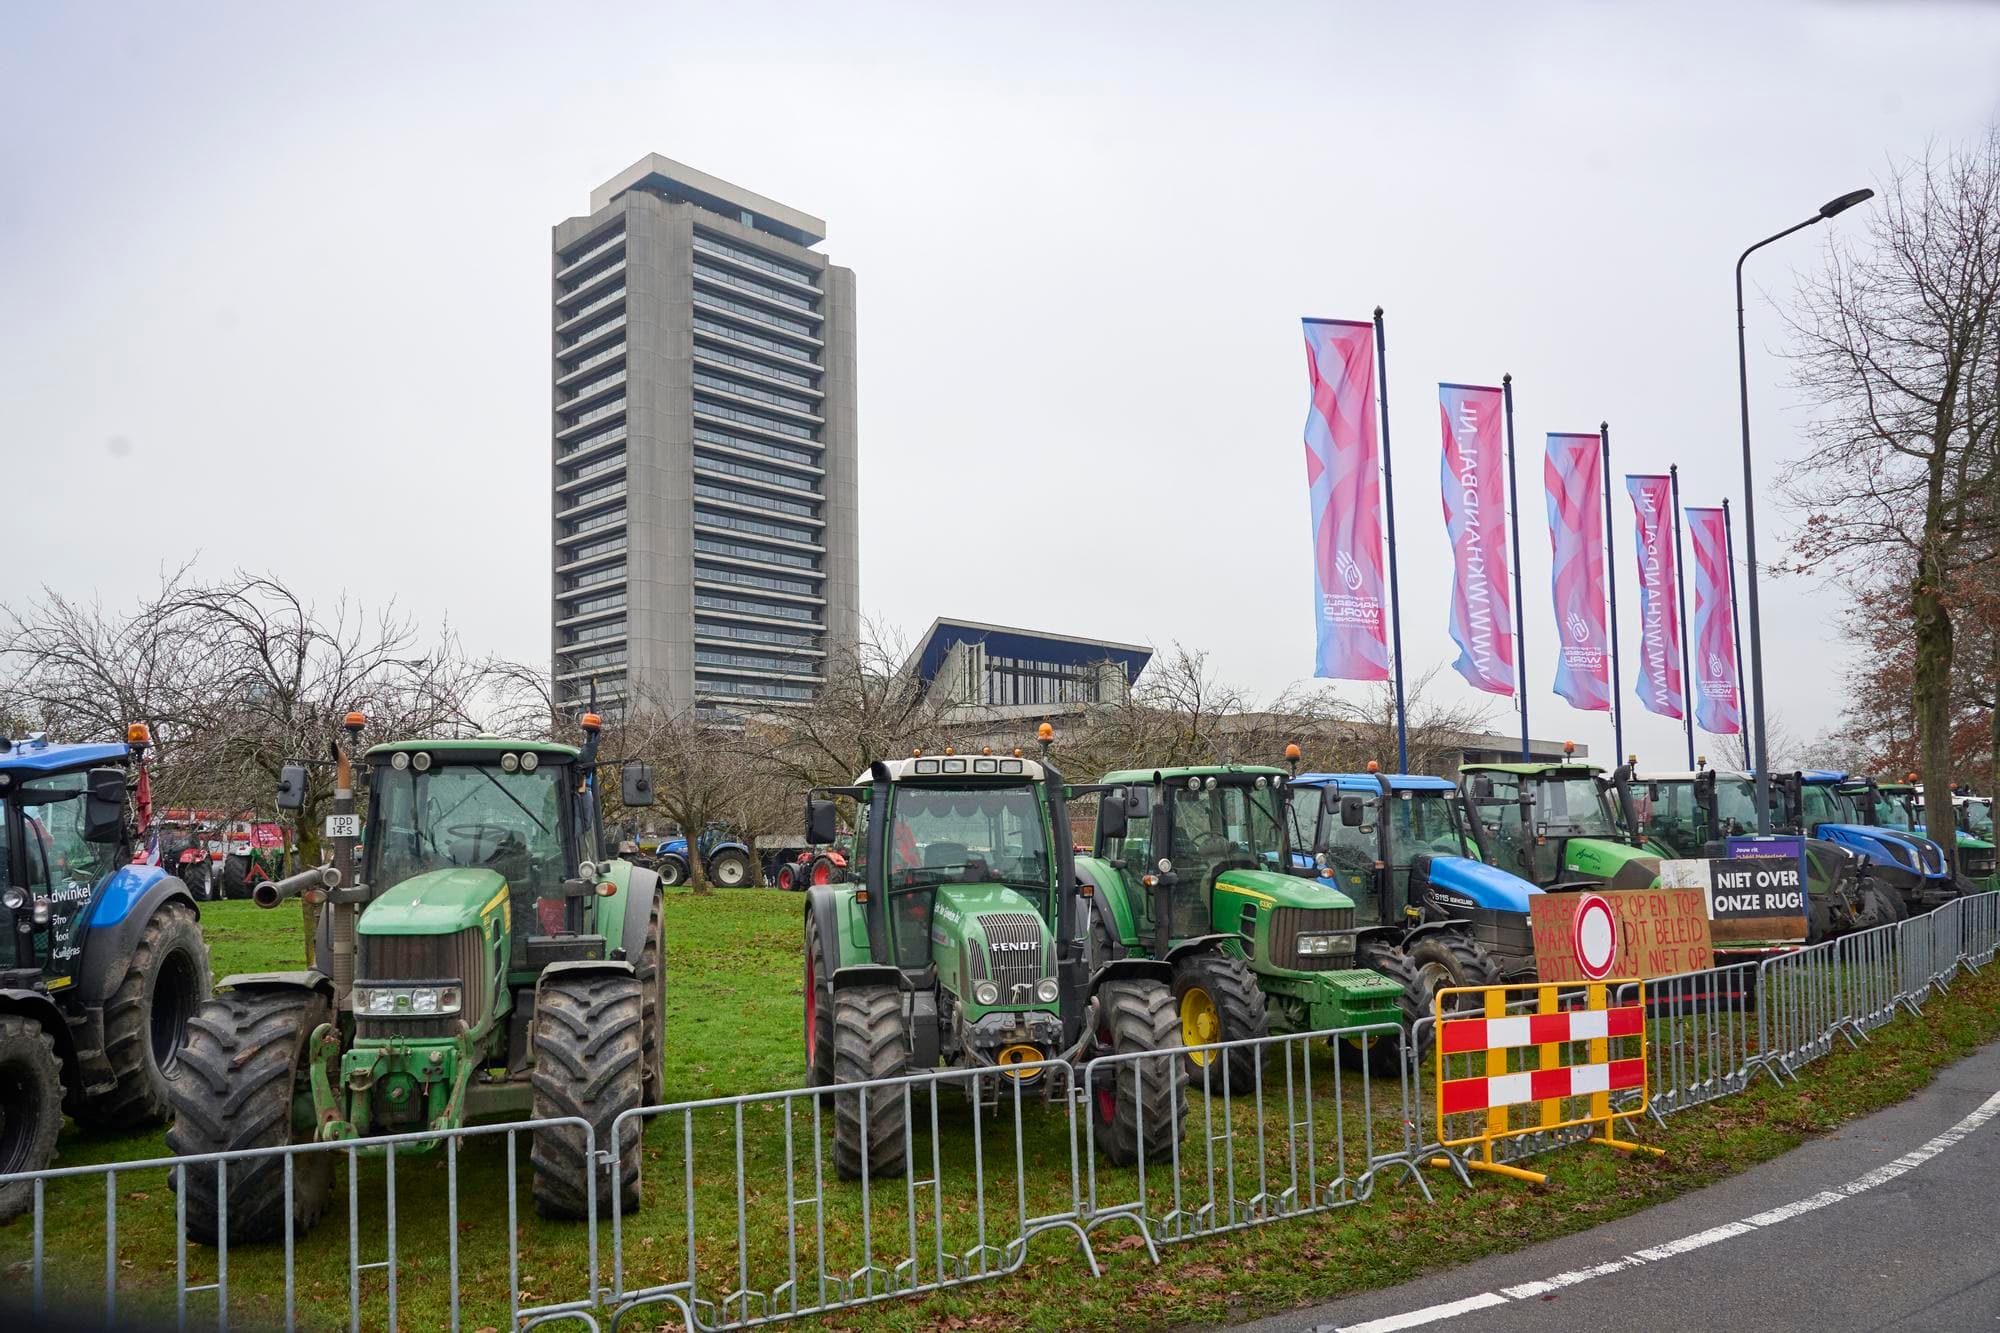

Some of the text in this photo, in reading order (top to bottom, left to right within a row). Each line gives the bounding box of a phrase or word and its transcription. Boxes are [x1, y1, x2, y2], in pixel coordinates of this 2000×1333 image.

[333, 817, 353, 826] TDD
[1717, 870, 1800, 889] NIET OVER
[1432, 893, 1449, 902] S115
[1629, 896, 1646, 917] OP
[1650, 895, 1667, 917] EN
[1674, 892, 1700, 916] TOP
[1714, 891, 1804, 912] ONZE RUG!
[1655, 916, 1703, 945] BELEID
[991, 941, 1038, 952] FENDT
[1649, 947, 1680, 976] NIET
